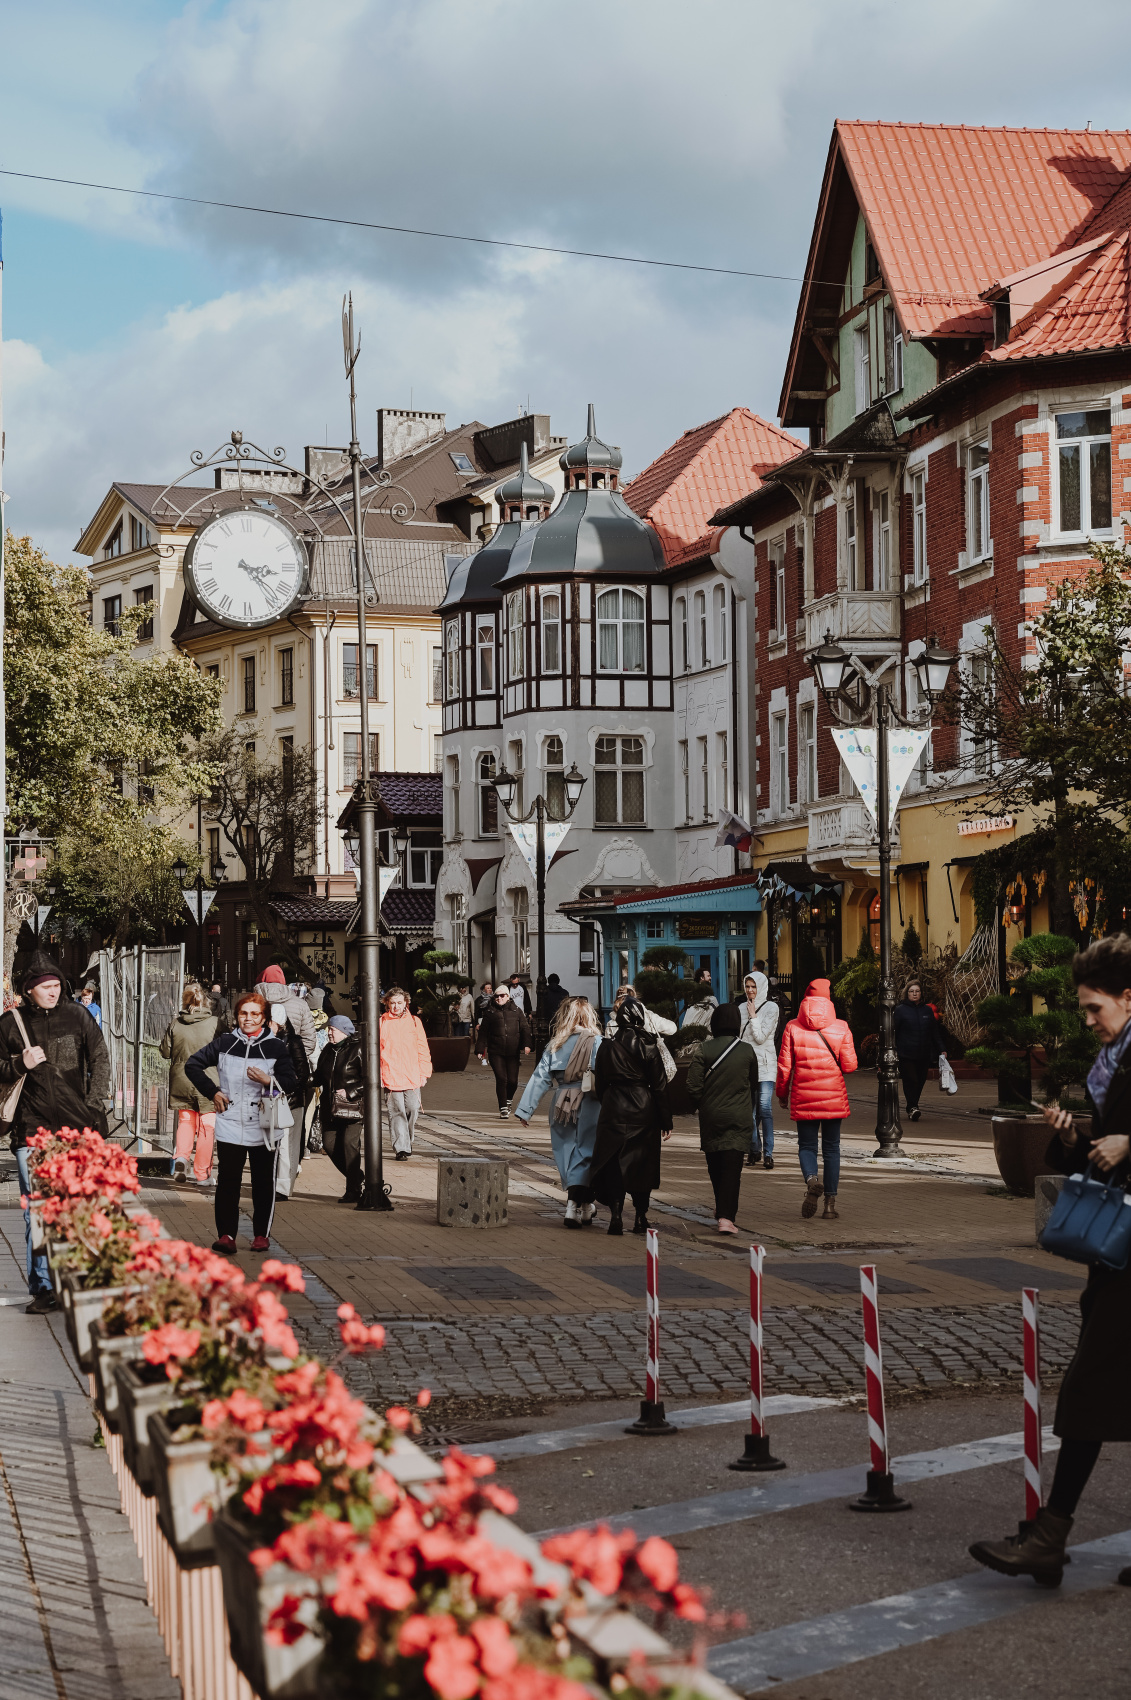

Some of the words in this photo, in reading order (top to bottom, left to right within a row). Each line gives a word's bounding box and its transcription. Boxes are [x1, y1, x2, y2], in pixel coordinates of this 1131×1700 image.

[219, 523, 233, 539] XI
[240, 519, 252, 532] XII
[263, 525, 271, 538] I
[203, 542, 219, 552] X
[276, 541, 290, 552] II
[198, 562, 213, 571] IX
[281, 563, 296, 572] III
[201, 578, 220, 597] VIII
[218, 594, 233, 612] VII
[243, 602, 253, 616] VI
